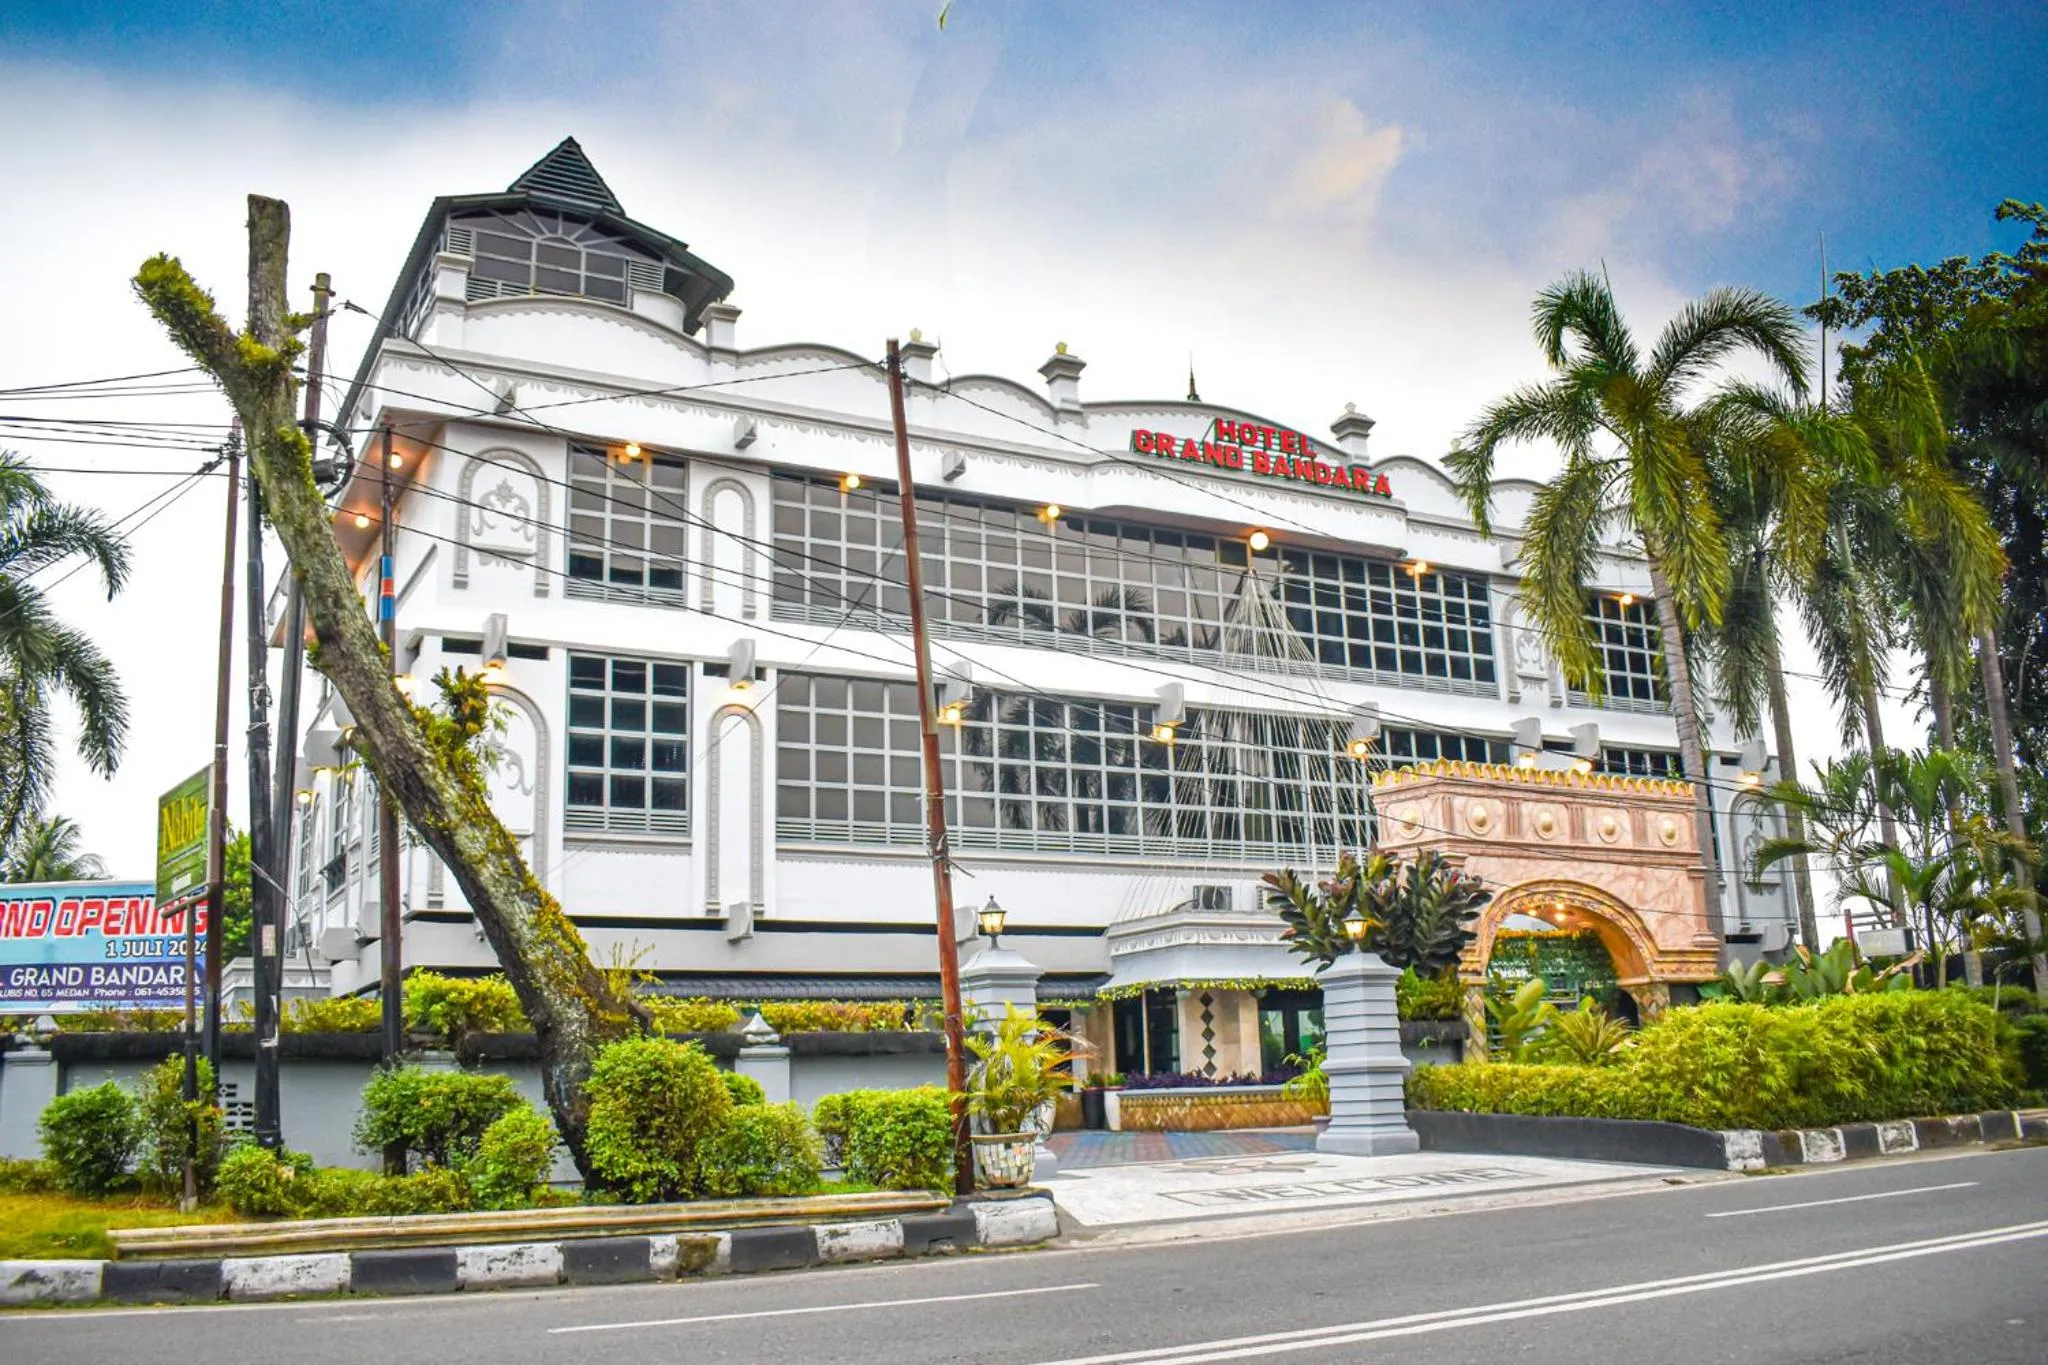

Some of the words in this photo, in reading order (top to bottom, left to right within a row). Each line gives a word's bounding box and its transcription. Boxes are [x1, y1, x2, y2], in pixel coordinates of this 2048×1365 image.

[1215, 417, 1317, 458] HOTEL
[1134, 428, 1244, 471] GRAND
[1252, 449, 1393, 498] BANDARA
[106, 940, 117, 957] 1
[121, 940, 163, 957] JULI
[10, 966, 83, 987] GRAND
[55, 987, 90, 997] MEDAN
[94, 986, 126, 997] Phone
[1201, 1168, 1518, 1201] WELCOME
